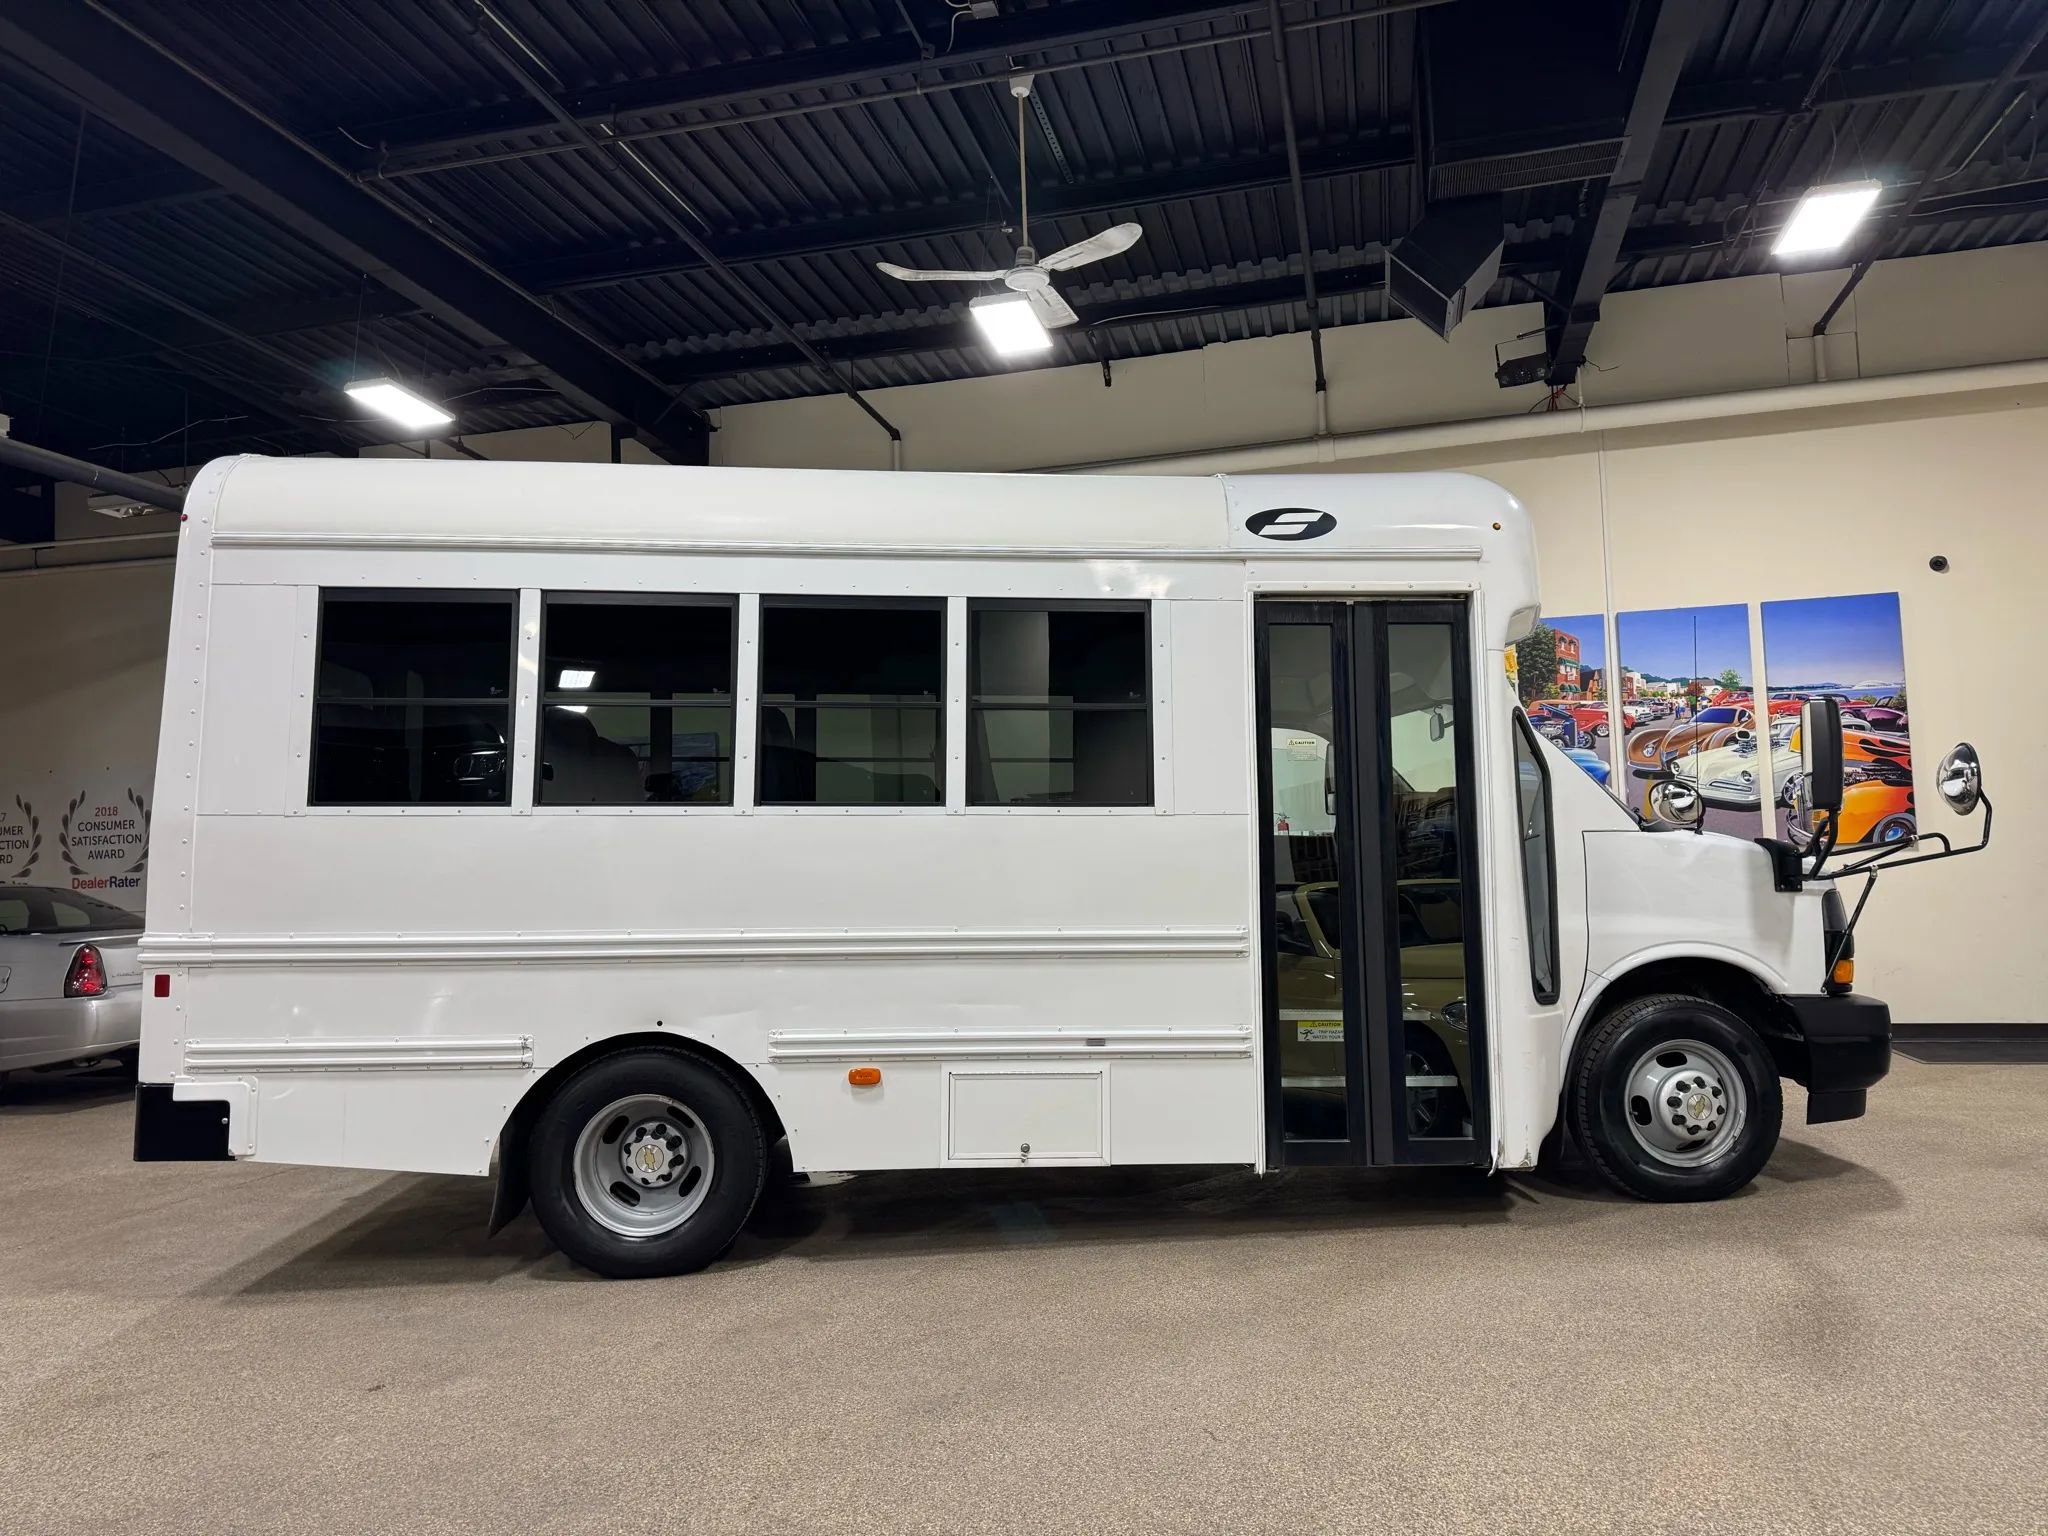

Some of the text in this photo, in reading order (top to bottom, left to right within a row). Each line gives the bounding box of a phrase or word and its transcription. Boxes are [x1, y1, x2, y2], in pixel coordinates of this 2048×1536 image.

[95, 806, 118, 817] 2018
[77, 819, 136, 832] CONSUMER
[71, 833, 142, 847] SATISFACTION
[88, 848, 125, 860] AWARD
[71, 876, 141, 890] DealerRater
